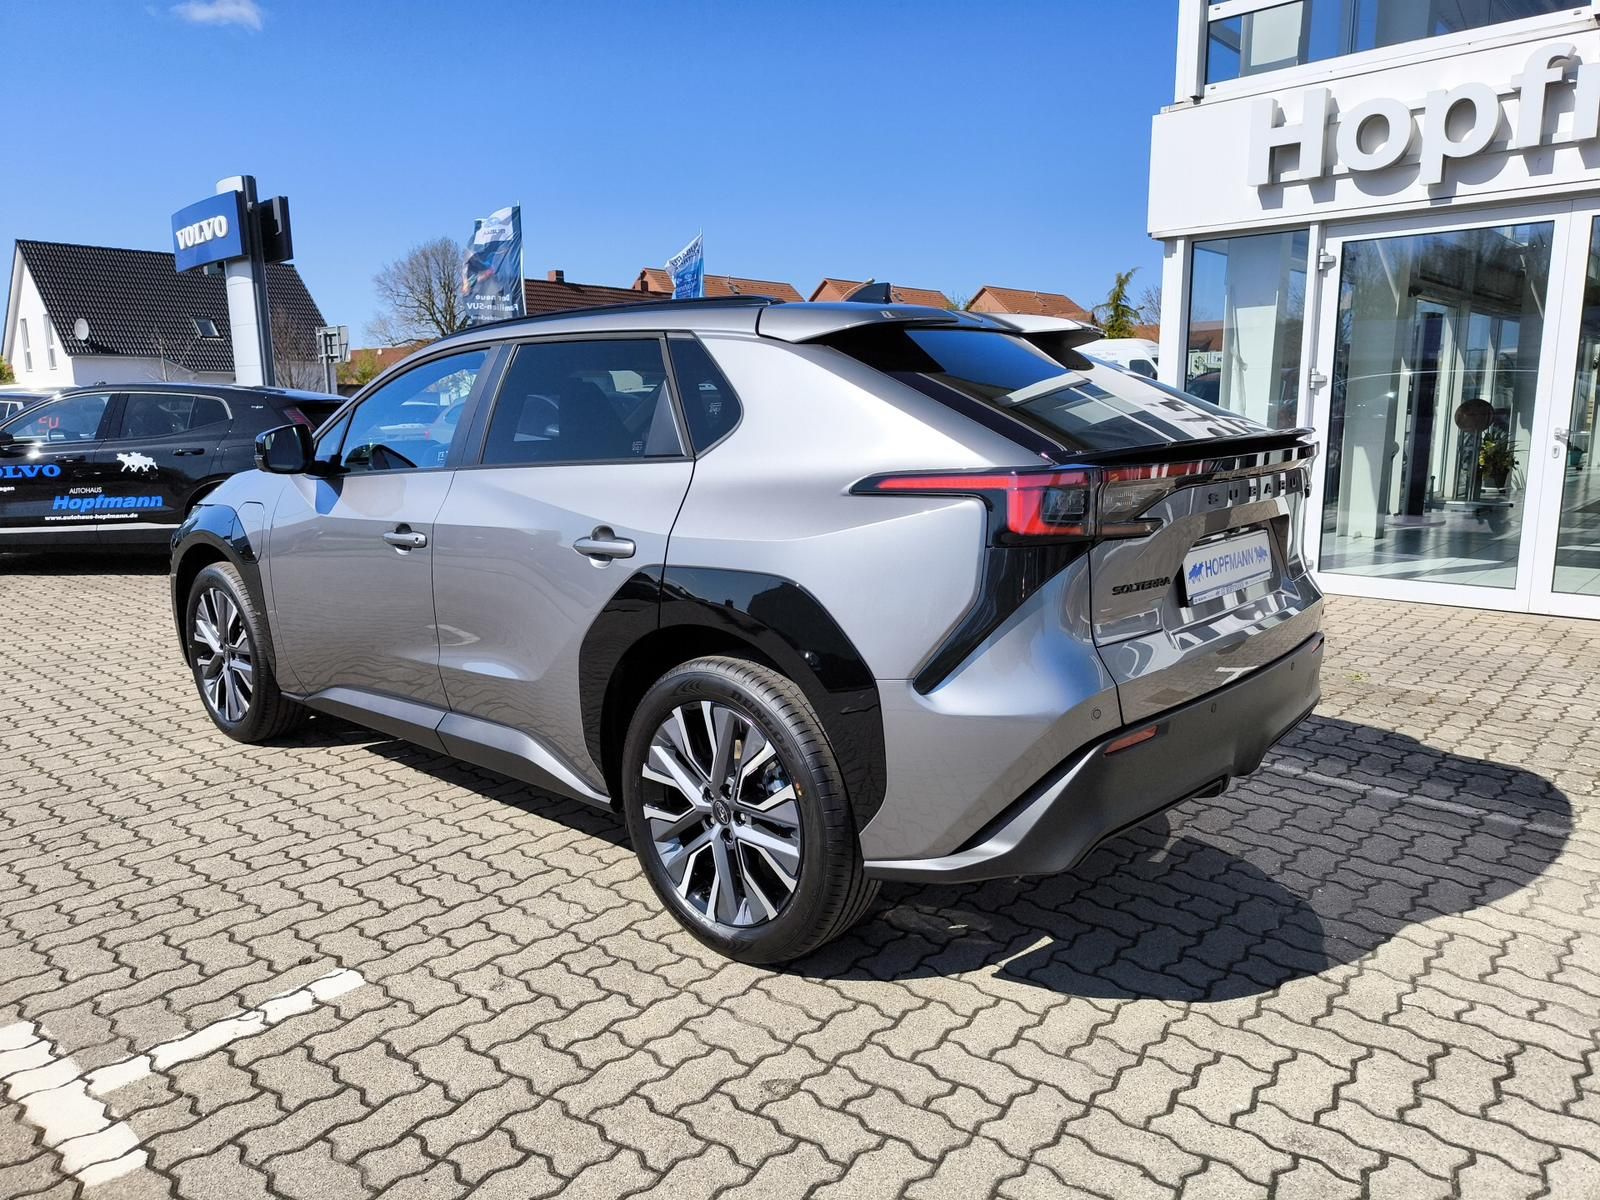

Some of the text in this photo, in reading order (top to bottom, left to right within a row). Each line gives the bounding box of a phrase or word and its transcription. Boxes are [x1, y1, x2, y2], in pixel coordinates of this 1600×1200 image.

[176, 215, 228, 250] VOLVO
[0, 464, 62, 479] LVO
[1208, 476, 1296, 505] SUBARU
[53, 494, 164, 513] Hopfmann
[45, 513, 138, 521] www.autohaus-hopfmann.de
[1205, 548, 1254, 578] HOPFMANN
[1112, 576, 1171, 596] SOLTERRA
[731, 690, 795, 760] DUNLOP
